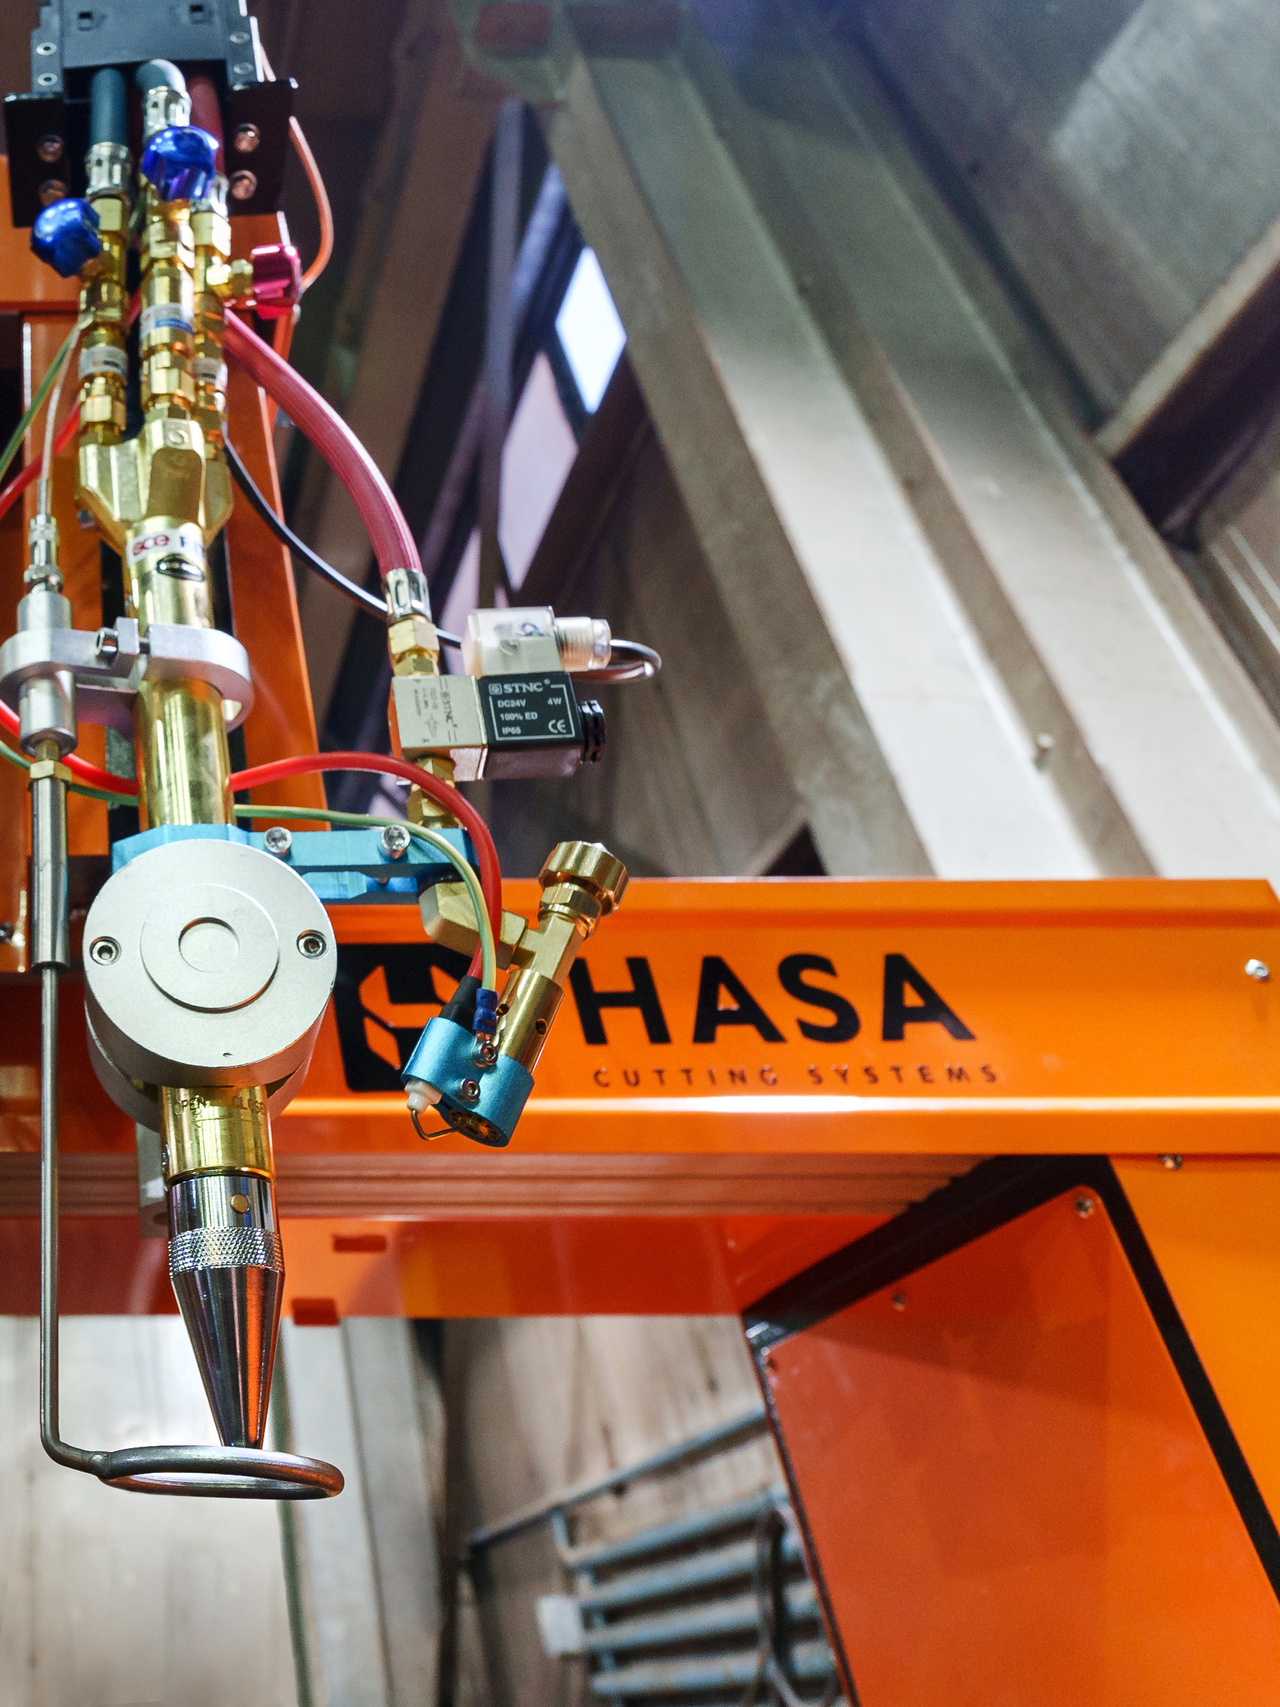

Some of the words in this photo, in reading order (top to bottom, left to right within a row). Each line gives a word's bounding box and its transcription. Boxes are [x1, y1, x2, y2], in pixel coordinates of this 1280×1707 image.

[503, 682, 544, 694] STNC
[497, 699, 527, 708] DC24V
[547, 697, 562, 706] 4W
[500, 713, 523, 721] 100%
[524, 711, 538, 720] ED
[567, 953, 977, 1045] HASA
[593, 1064, 780, 1088] CUTTING
[808, 1063, 998, 1085] SYSTEMS
